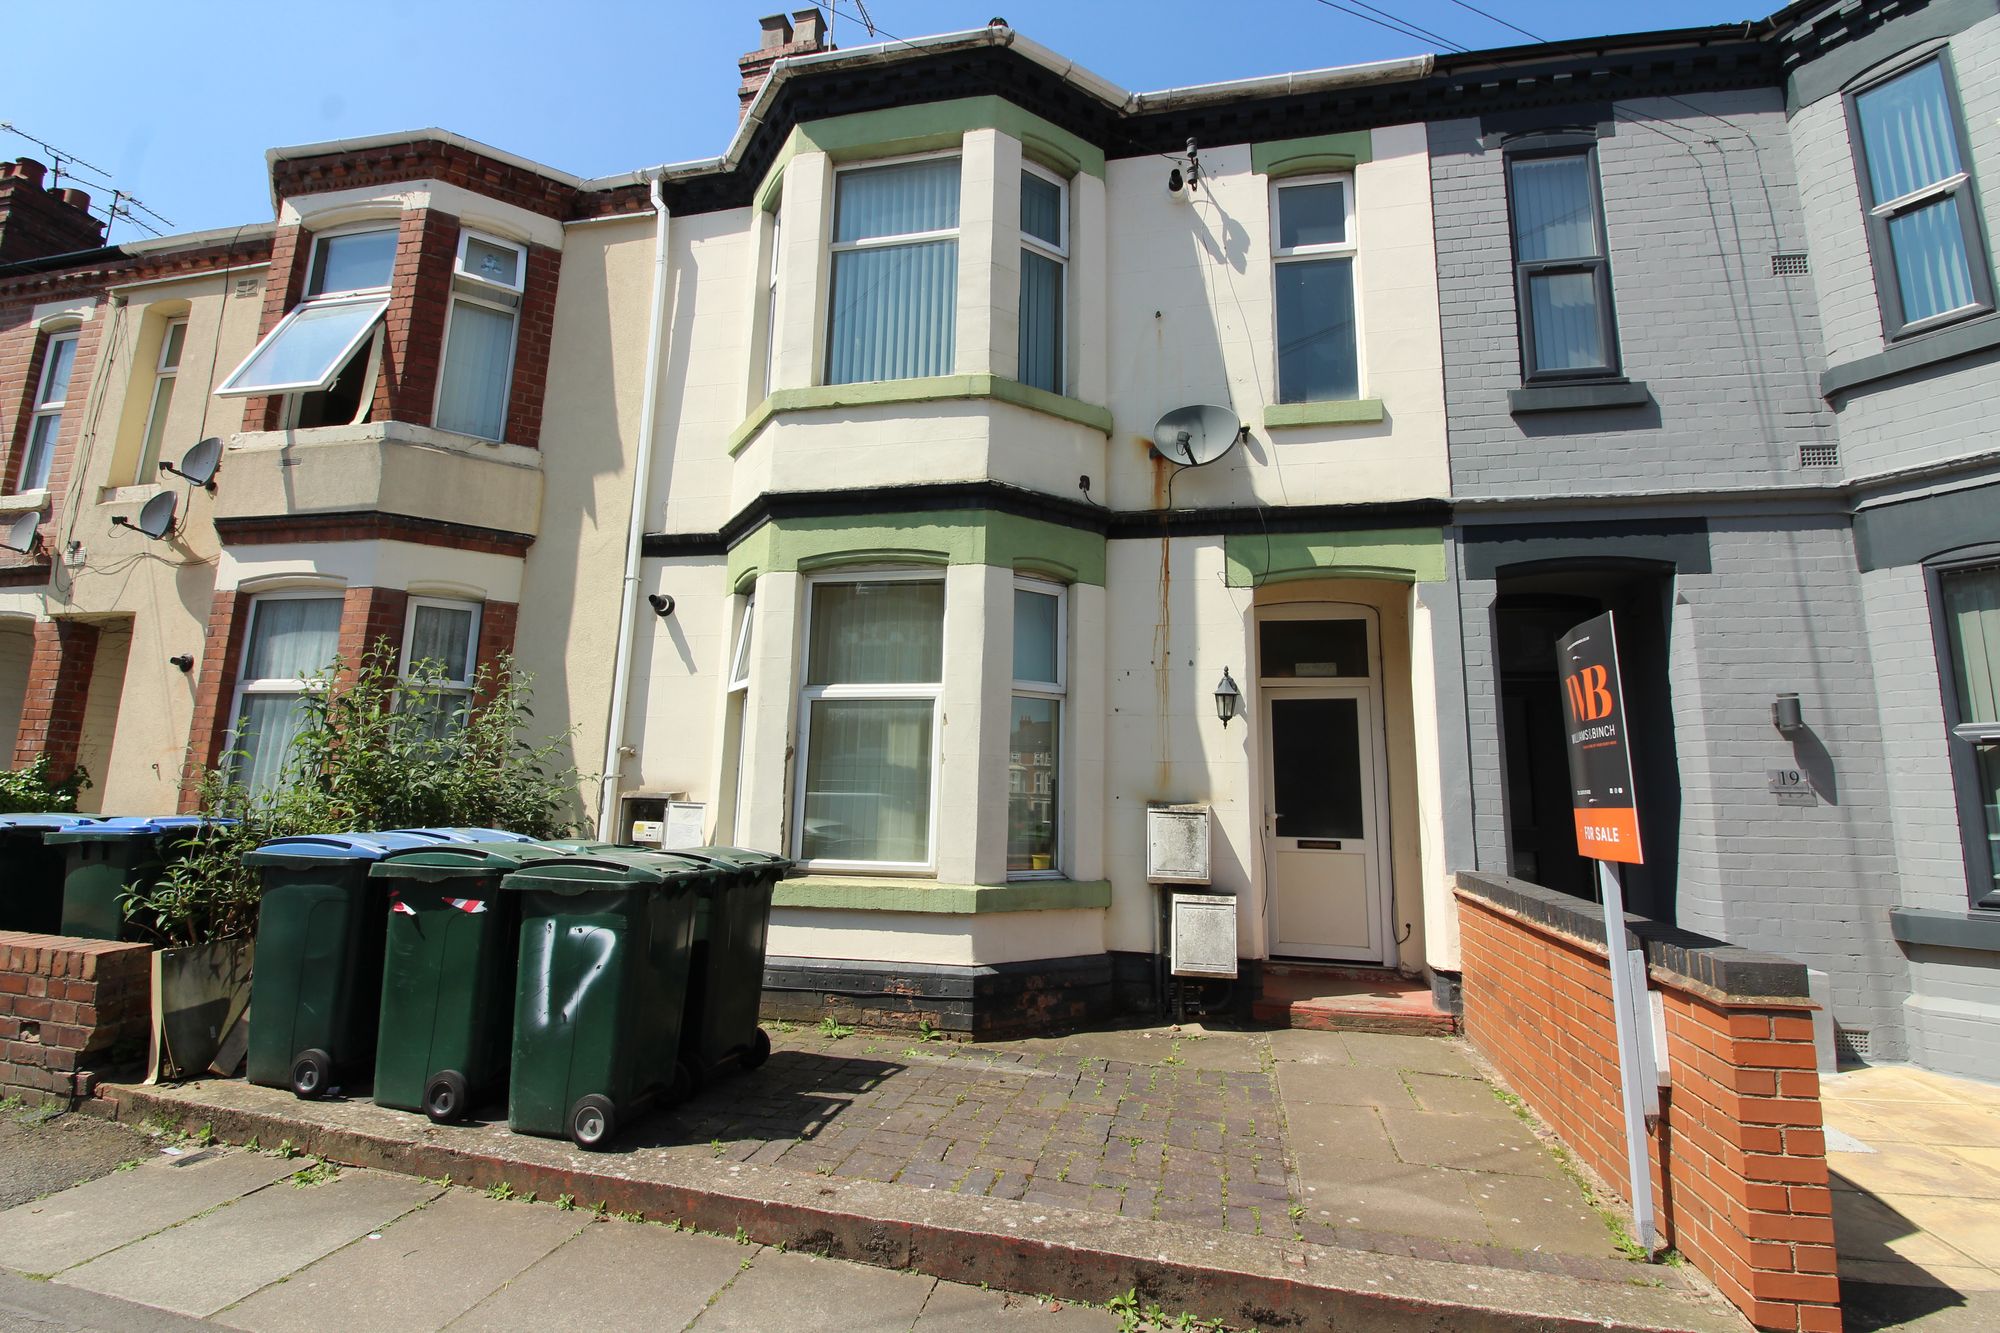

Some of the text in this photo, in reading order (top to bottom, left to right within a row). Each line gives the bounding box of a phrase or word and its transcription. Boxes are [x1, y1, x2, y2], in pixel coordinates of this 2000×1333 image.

[1780, 771, 1800, 785] 19
[1584, 825, 1620, 842] FOR SALE
[538, 919, 616, 1026] 17
